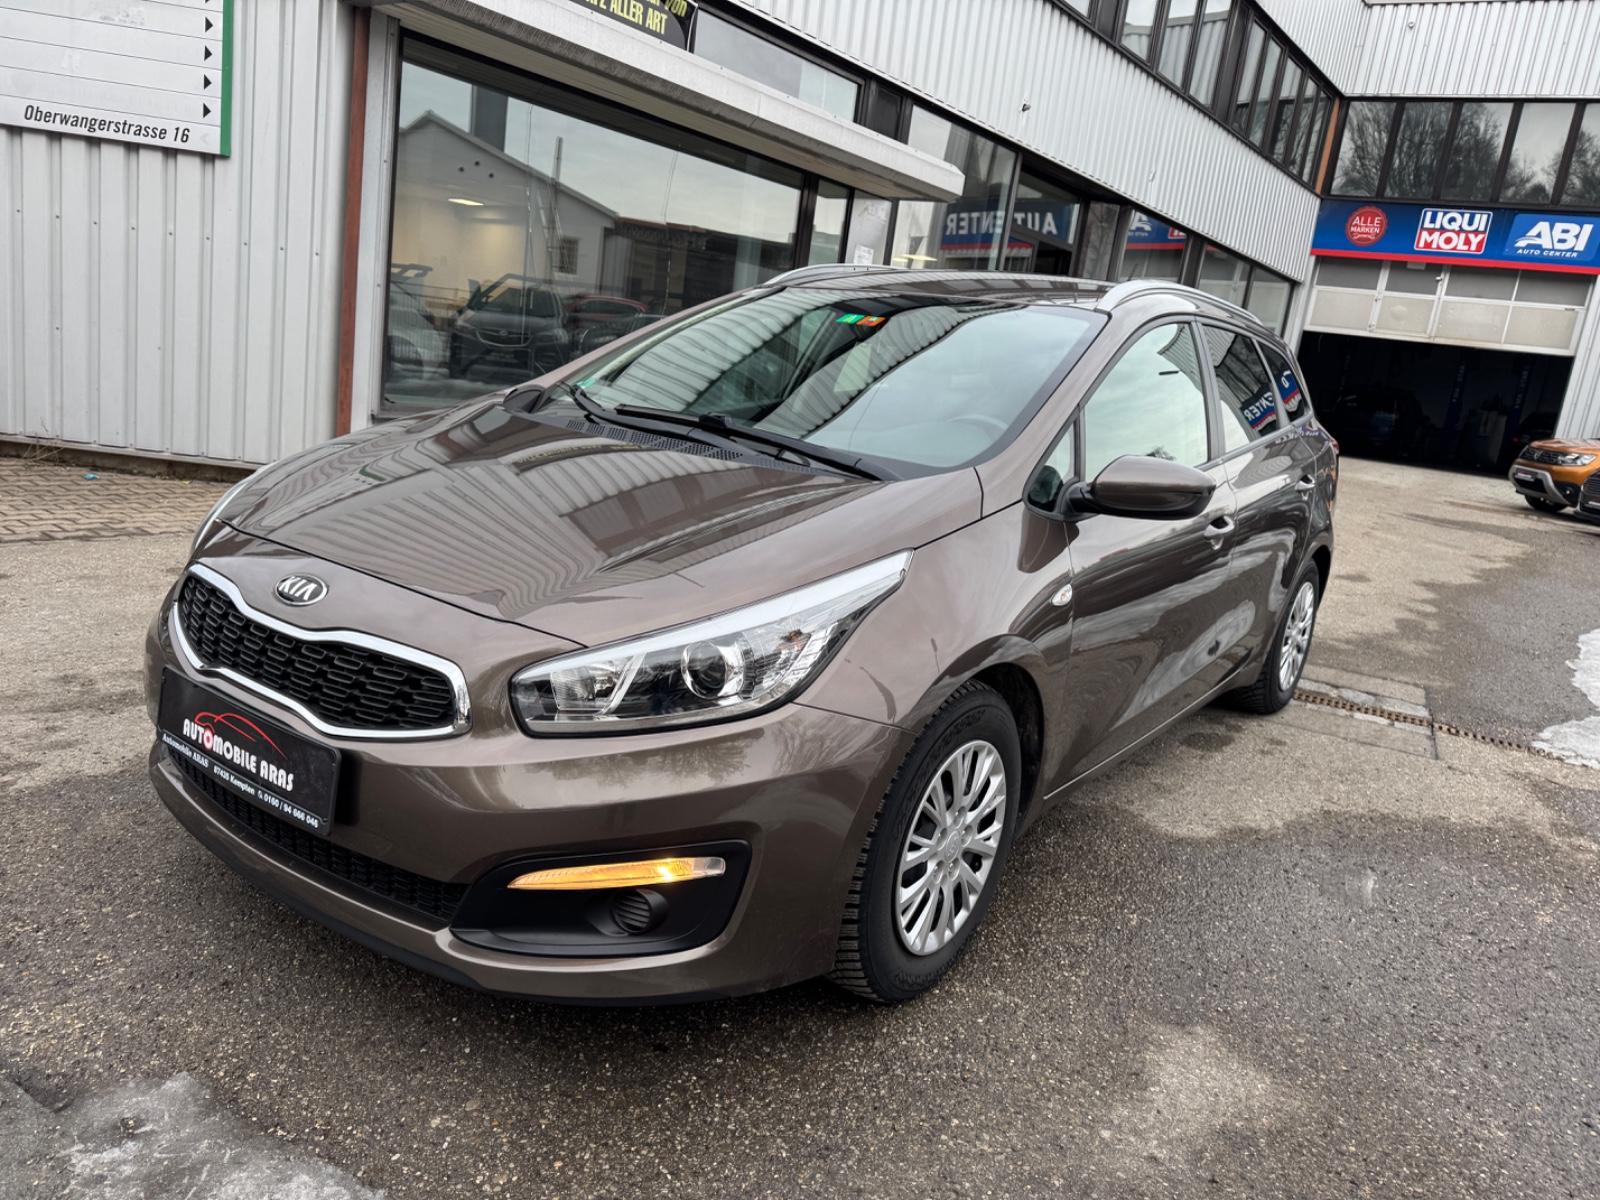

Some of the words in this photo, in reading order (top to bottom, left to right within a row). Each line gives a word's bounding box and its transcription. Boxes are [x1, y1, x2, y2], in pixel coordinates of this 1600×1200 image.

[610, 0, 643, 25] ALLER
[645, 8, 667, 34] ART
[24, 104, 168, 140] Oberwangerstrasse
[174, 126, 190, 143] 16
[1350, 225, 1380, 234] MARKEN
[1352, 215, 1382, 227] ALLE
[1423, 211, 1488, 231] LIQUI
[1418, 230, 1485, 251] MOLY
[1514, 221, 1594, 251] ABI
[1516, 248, 1541, 256] AUTO
[1543, 250, 1578, 259] CENTER
[279, 576, 318, 601] KIA
[183, 718, 257, 774] AUTOMOBILE
[260, 760, 294, 791] ARAS
[192, 752, 209, 768] ARAS
